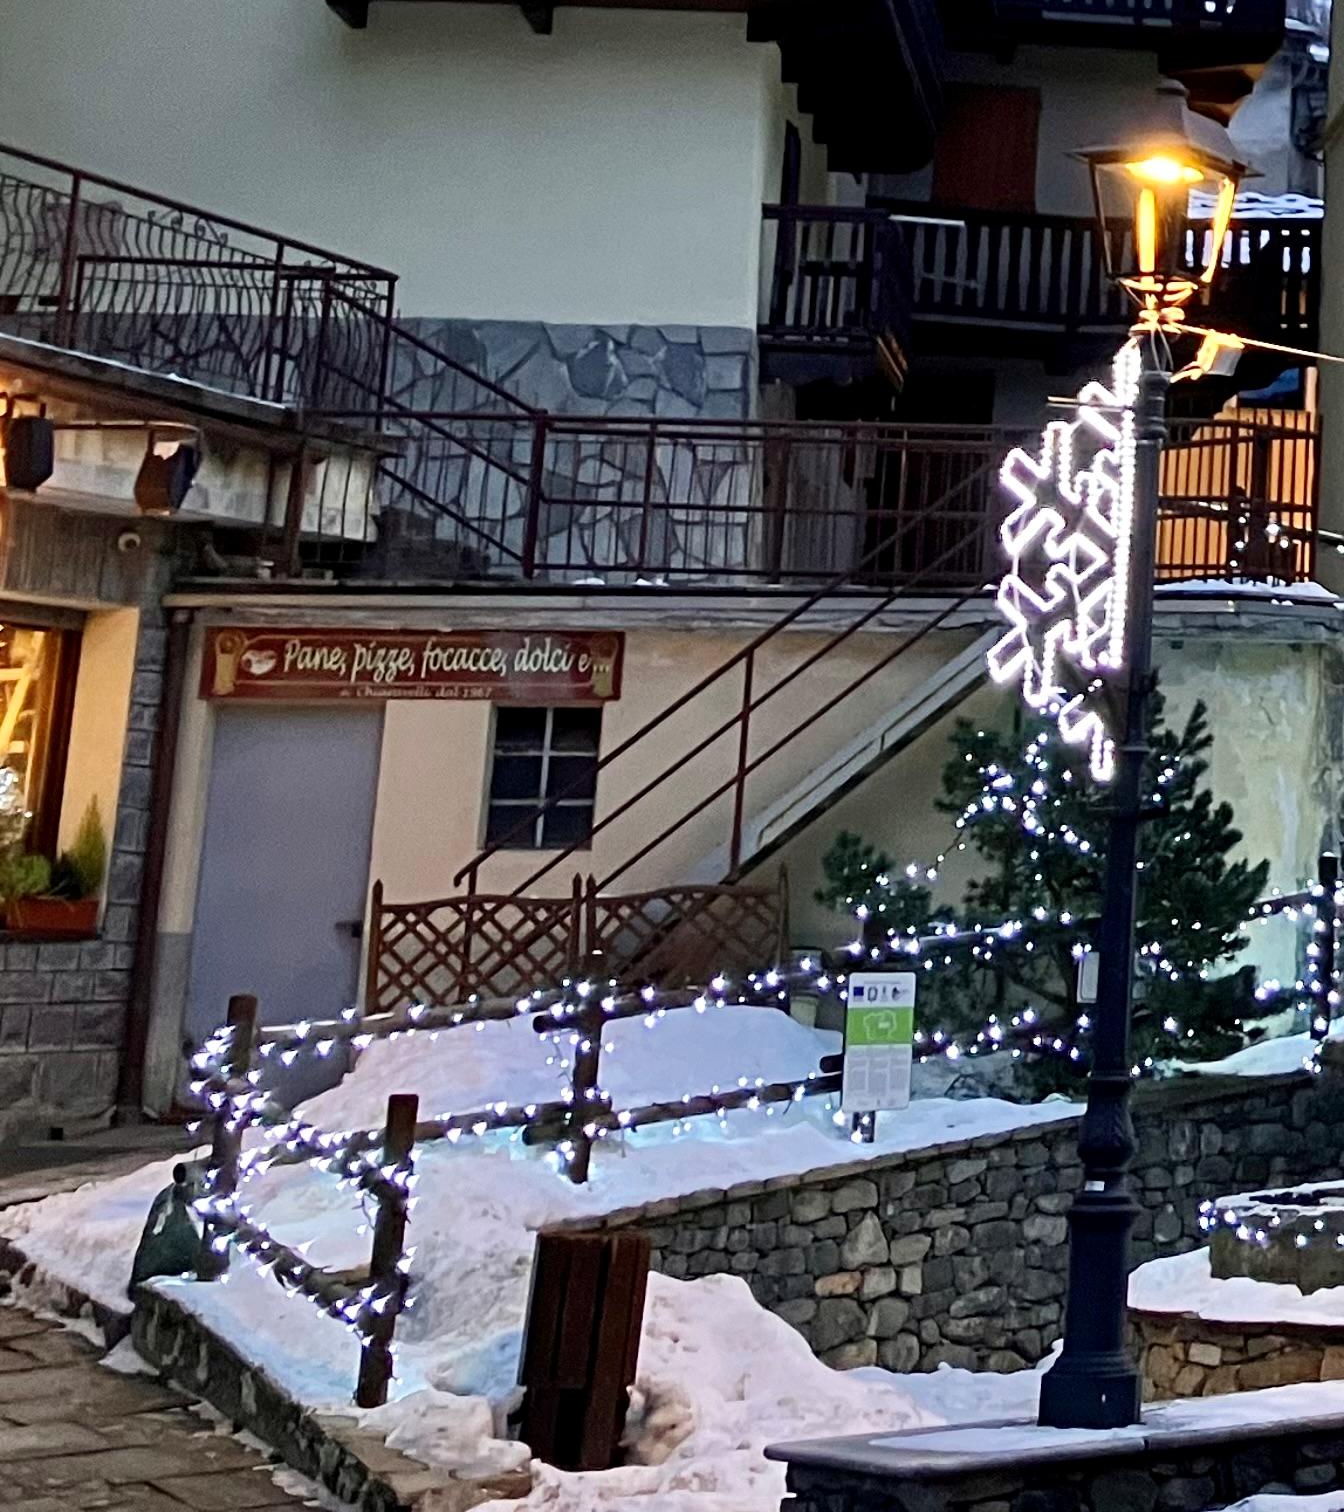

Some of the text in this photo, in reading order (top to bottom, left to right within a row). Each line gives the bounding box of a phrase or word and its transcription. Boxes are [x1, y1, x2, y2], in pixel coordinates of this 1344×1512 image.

[284, 638, 347, 677] Pane,
[350, 640, 415, 684] pizze,
[421, 635, 508, 679] focacce,
[514, 637, 575, 673] dolci
